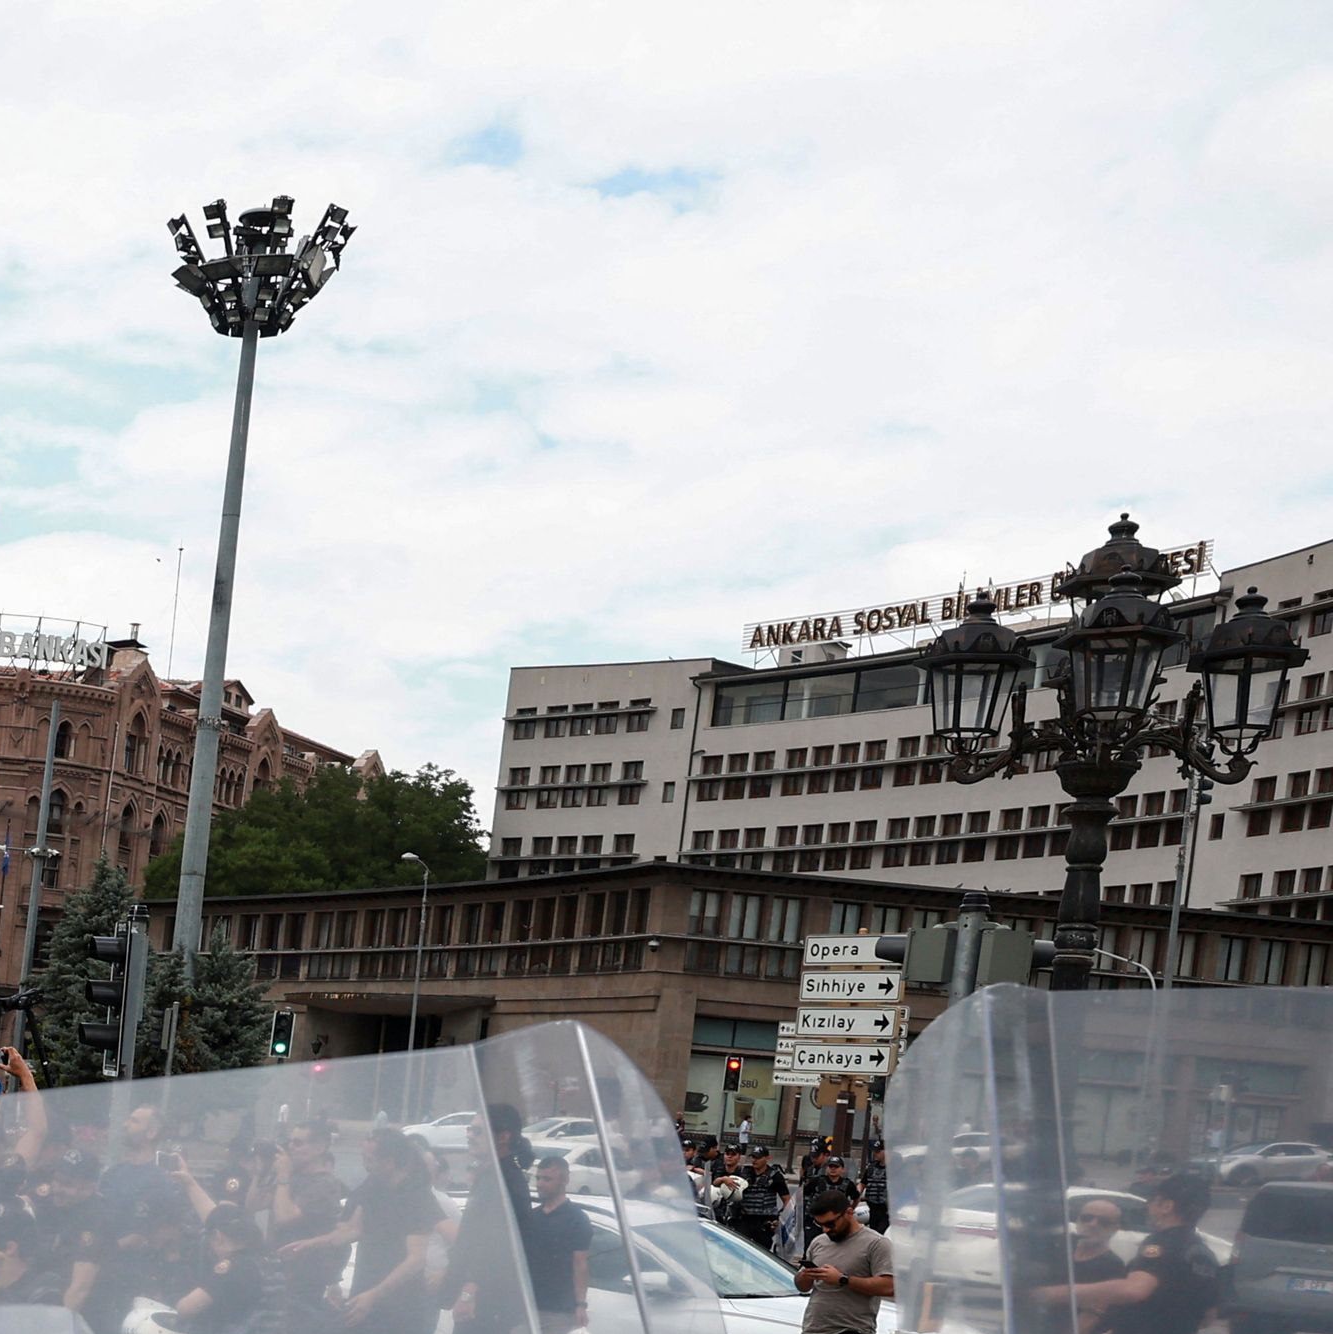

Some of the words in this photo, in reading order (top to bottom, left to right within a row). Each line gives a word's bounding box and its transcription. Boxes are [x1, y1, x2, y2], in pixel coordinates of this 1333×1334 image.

[749, 616, 843, 648] ANKARA
[853, 601, 933, 634] SOSYAL
[941, 581, 1043, 621] BİLMLER
[811, 943, 859, 959] Opera
[806, 979, 866, 996] Sıhhiye
[801, 1014, 855, 1031] Kızılay
[797, 1050, 862, 1068] Çankaya
